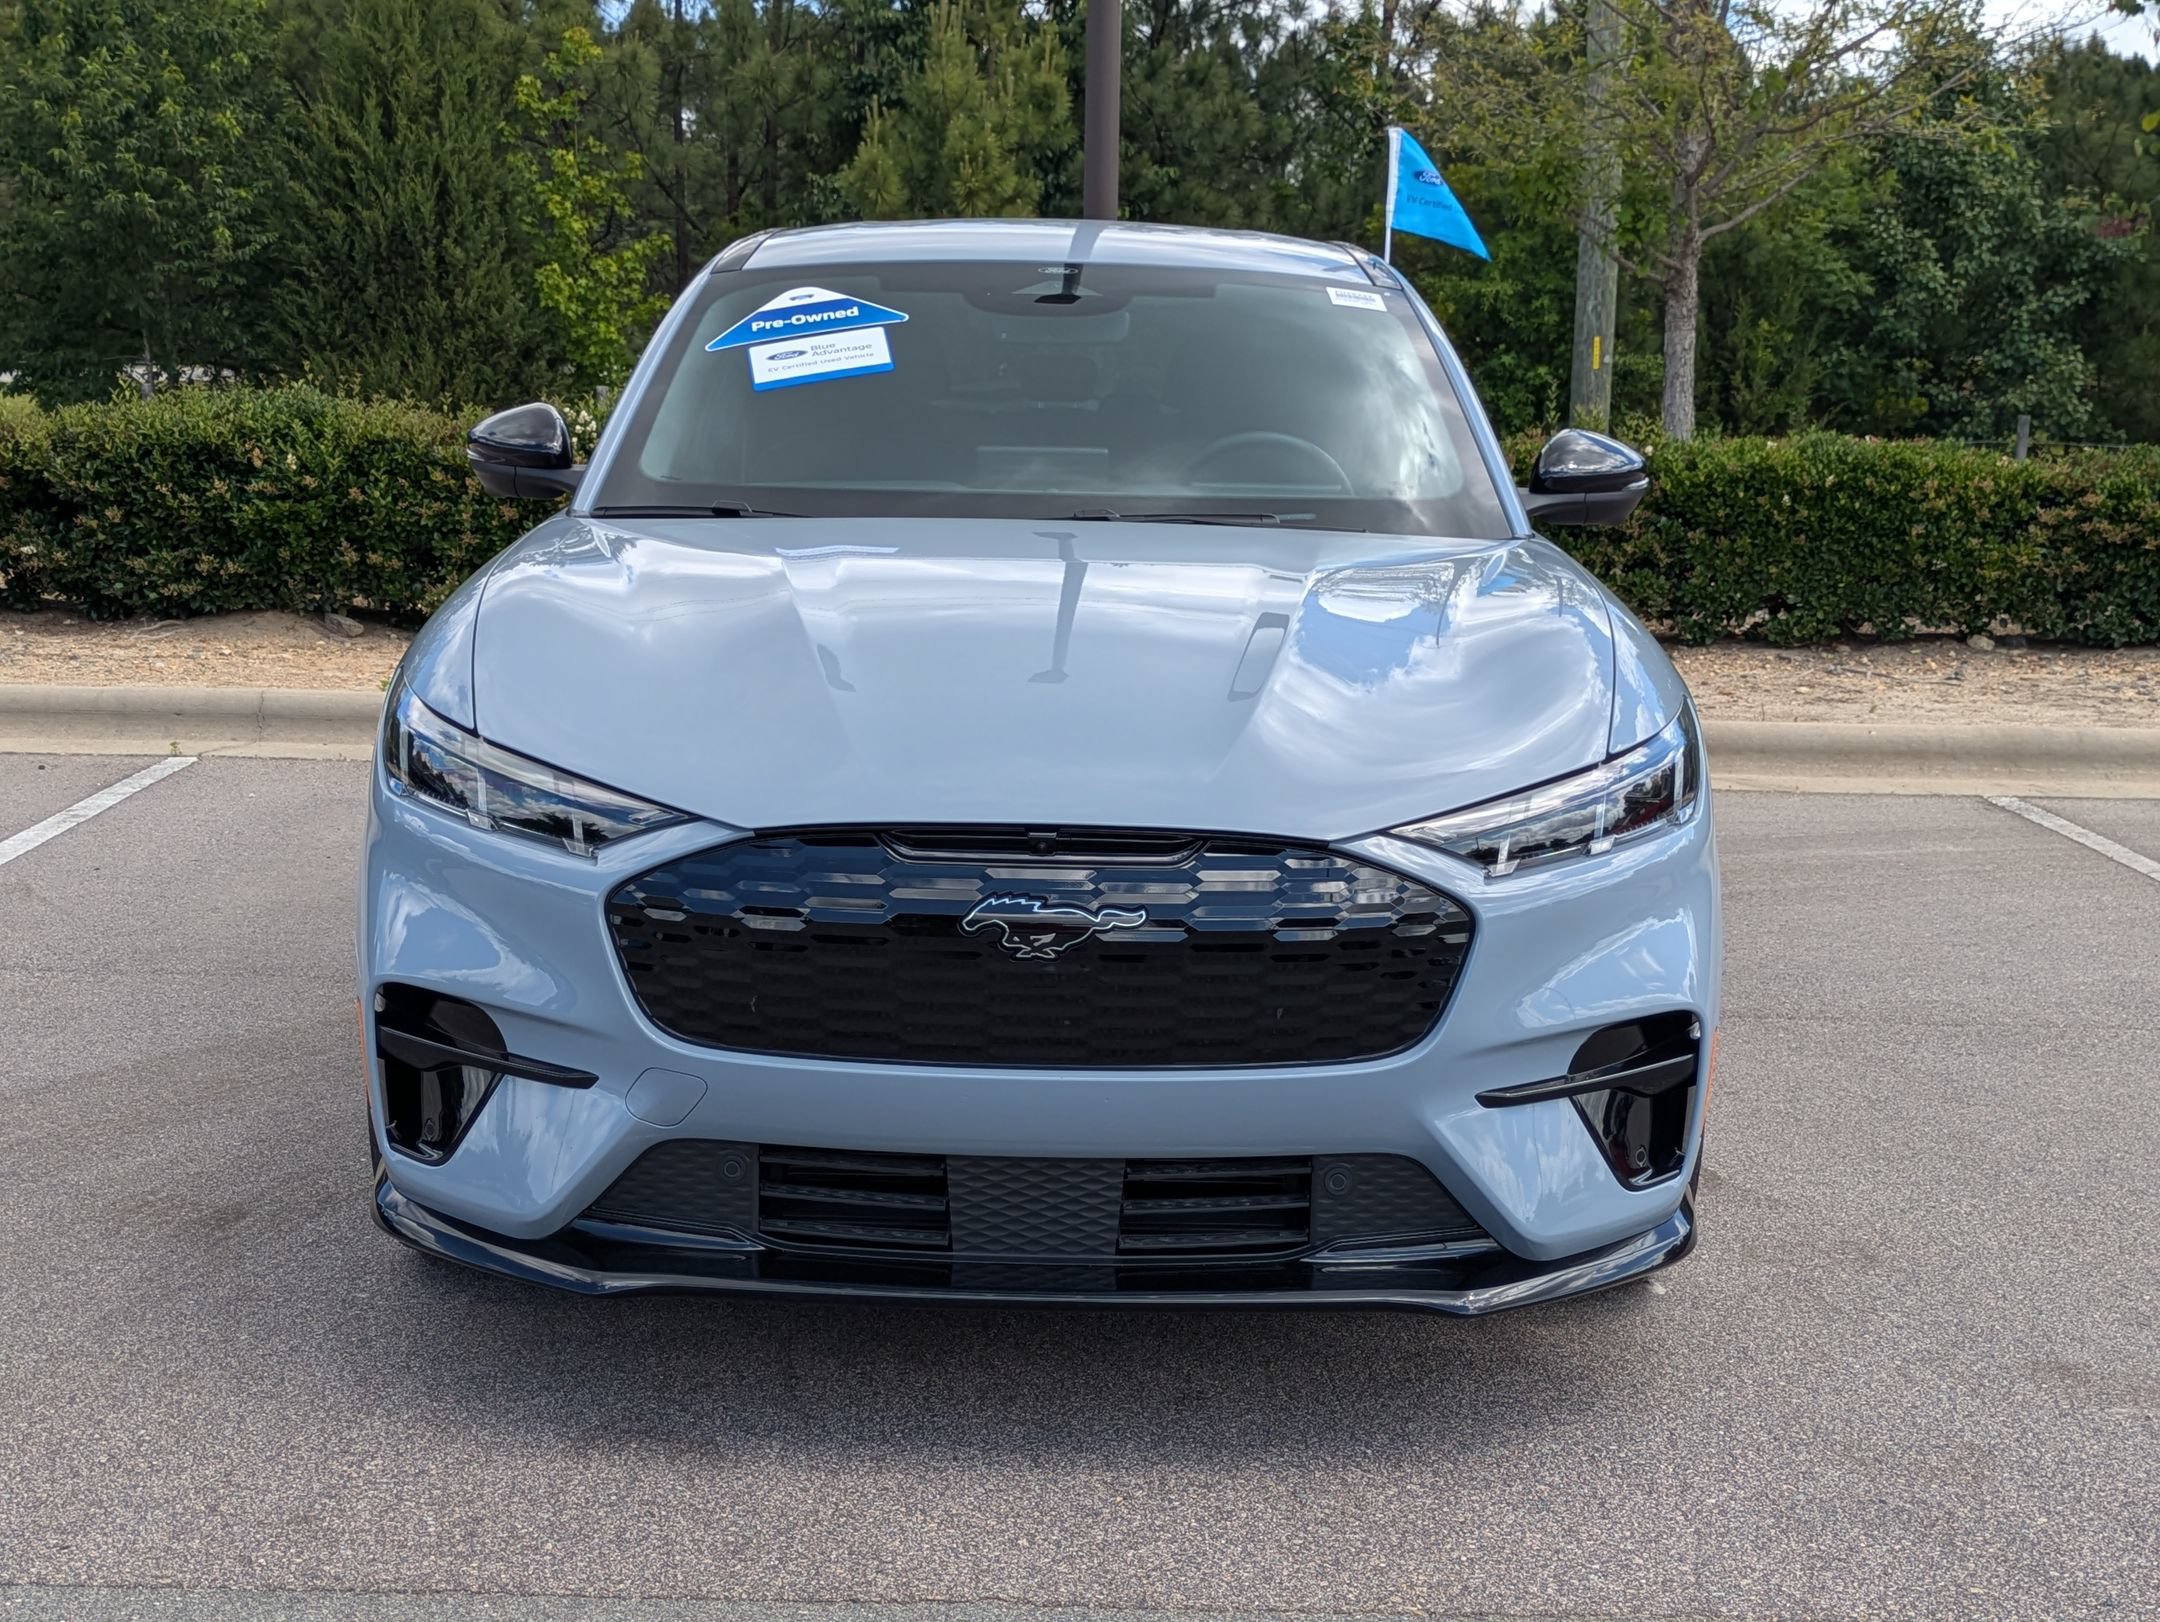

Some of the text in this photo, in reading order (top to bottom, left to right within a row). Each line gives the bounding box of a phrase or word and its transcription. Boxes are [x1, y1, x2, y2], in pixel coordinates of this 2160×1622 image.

[751, 306, 859, 332] Pre-Owned
[810, 342, 836, 352] Blue
[811, 343, 873, 358] Advantage
[781, 360, 819, 371] Certified
[820, 357, 842, 365] Used
[845, 352, 874, 361] Vehicle
